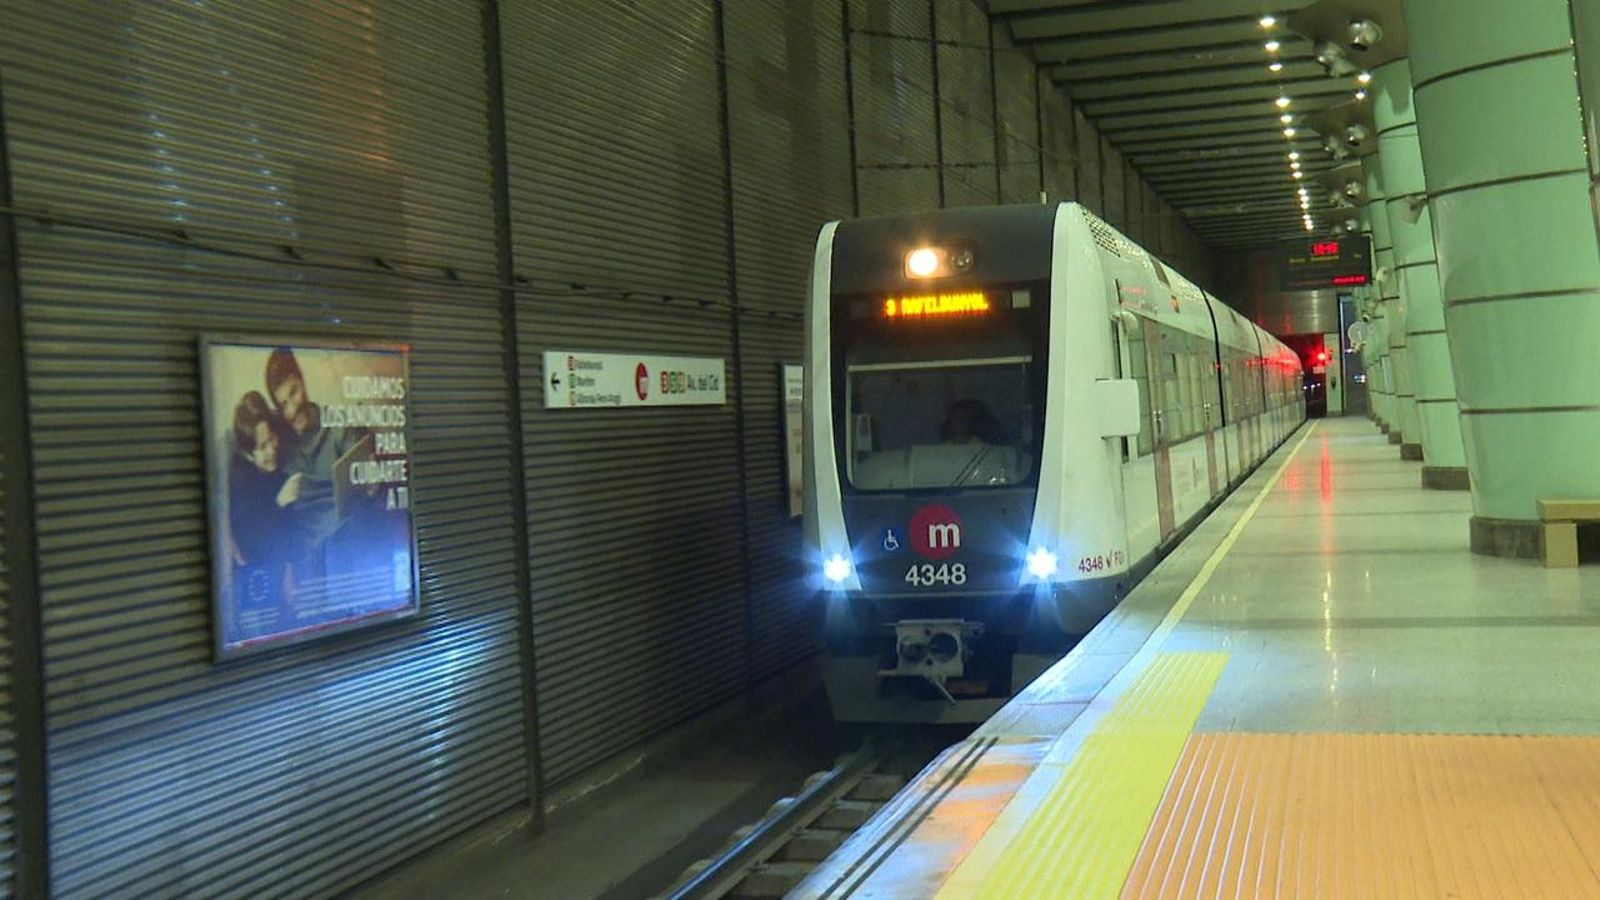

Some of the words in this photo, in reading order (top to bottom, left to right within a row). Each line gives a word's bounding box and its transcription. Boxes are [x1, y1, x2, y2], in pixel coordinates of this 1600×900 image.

[375, 432, 407, 455] PARA
[350, 460, 408, 485] CUIDARTE
[928, 523, 961, 549] m
[905, 563, 967, 587] 4348
[1079, 555, 1104, 573] 4348
